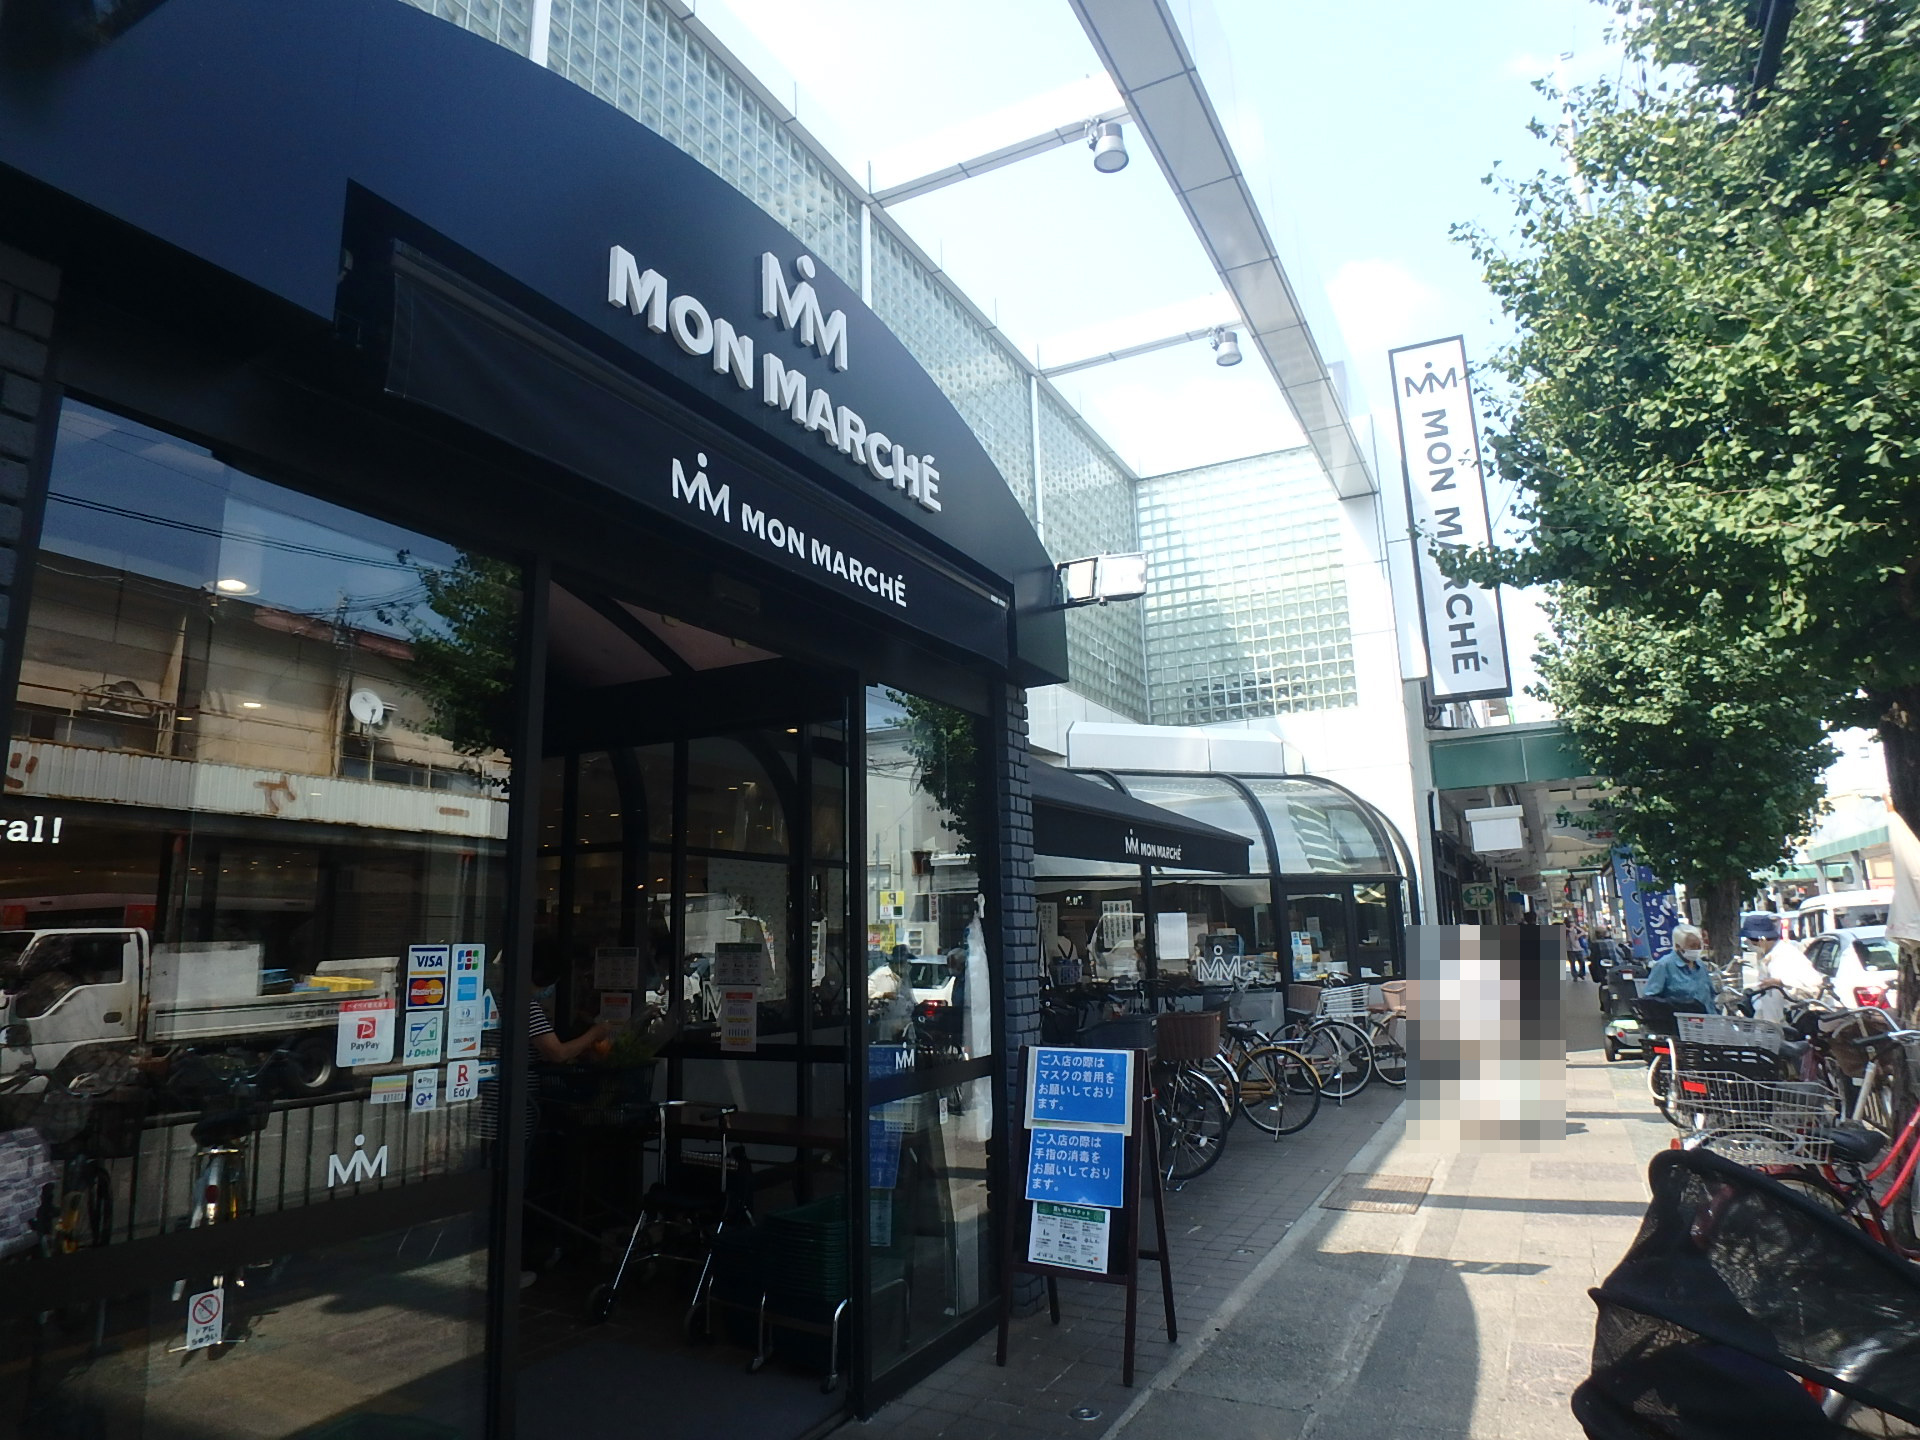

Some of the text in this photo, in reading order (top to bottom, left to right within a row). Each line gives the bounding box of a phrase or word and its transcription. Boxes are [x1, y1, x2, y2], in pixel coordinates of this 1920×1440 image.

[607, 245, 942, 513] MON MARCHÉ
[1421, 408, 1489, 675] MON MRCHÉ
[741, 502, 806, 559] MON
[811, 538, 907, 608] MARCHÉ
[1140, 842, 1157, 858] MON
[1157, 844, 1182, 861] MARCHÉ
[416, 955, 443, 968] VISA
[350, 1041, 380, 1051] PayPay
[1040, 1054, 1105, 1068] ご入店の際は
[1039, 1069, 1115, 1084] マスクの着用を
[453, 1087, 471, 1098] Edy
[1038, 1083, 1115, 1099] お願いしており
[1037, 1098, 1064, 1111] ます。
[1036, 1133, 1102, 1148] ご入店の際は
[1034, 1148, 1101, 1164] 手指の消毒を
[1032, 1163, 1111, 1180] お願いしており
[1032, 1178, 1060, 1192] ます。
